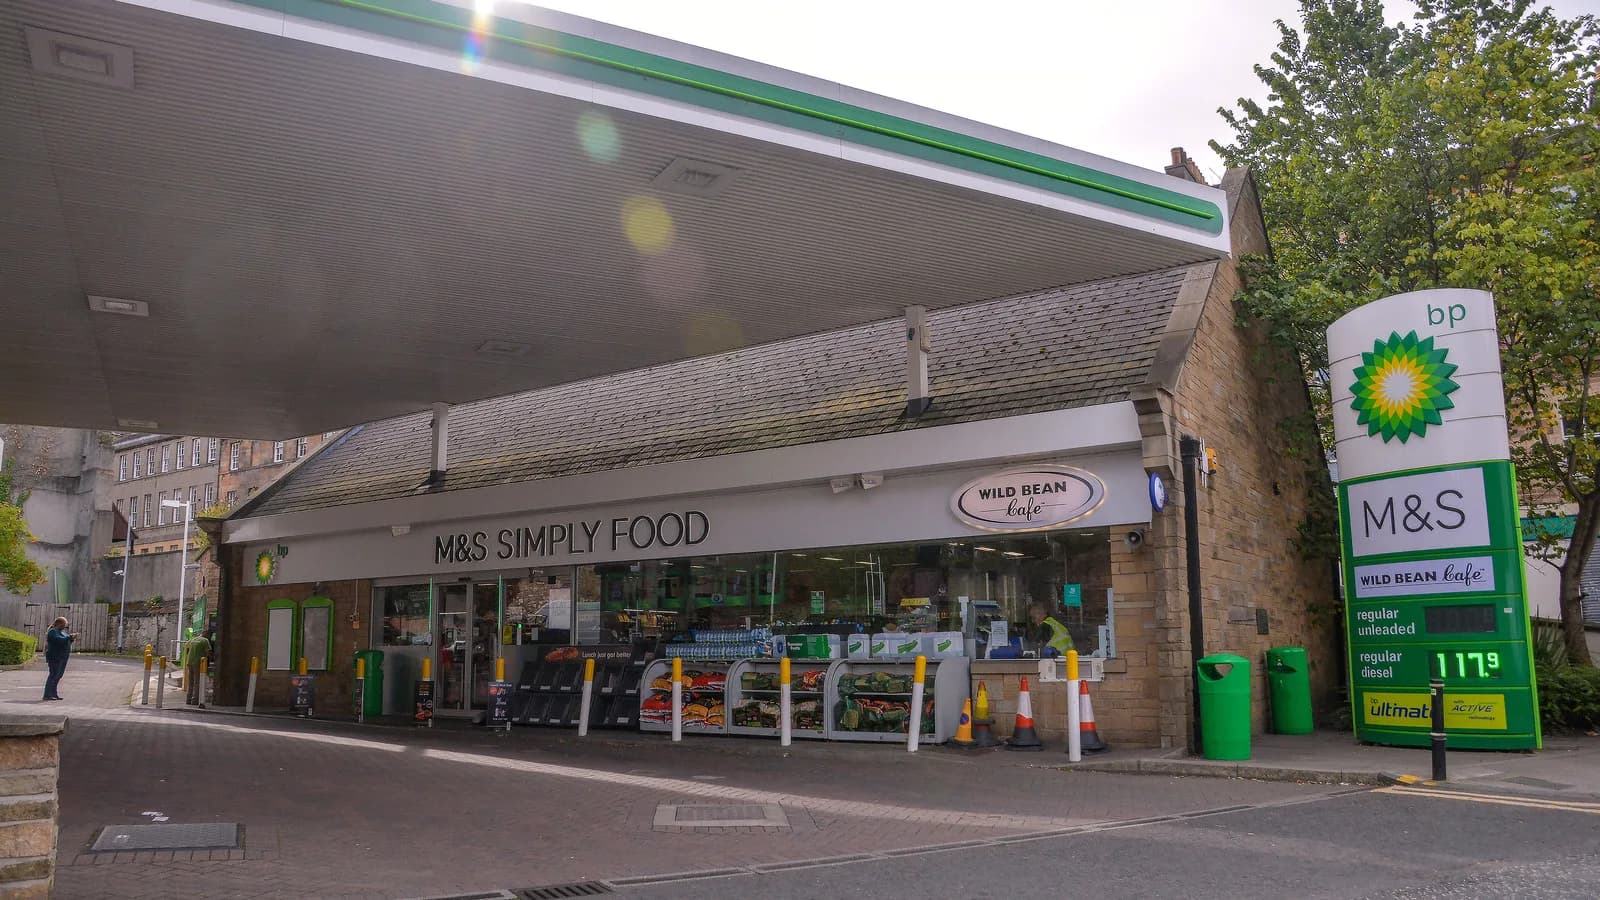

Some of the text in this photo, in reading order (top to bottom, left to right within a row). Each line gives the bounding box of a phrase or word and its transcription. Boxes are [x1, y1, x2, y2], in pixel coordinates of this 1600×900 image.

[1427, 303, 1466, 328] bp
[979, 481, 1067, 500] WILD BEAN
[1363, 489, 1466, 538] M&S
[434, 510, 710, 564] M&S SIMPLY FOOD
[277, 543, 289, 559] bp
[1360, 574, 1391, 586] WILD
[1395, 571, 1437, 584] BEAN
[1357, 607, 1399, 622] regular
[1358, 622, 1415, 636] unleaded
[582, 650, 596, 658] Lunch
[1360, 650, 1402, 664] regular
[1361, 666, 1393, 678] diesel
[1451, 704, 1494, 713] ACTIVE
